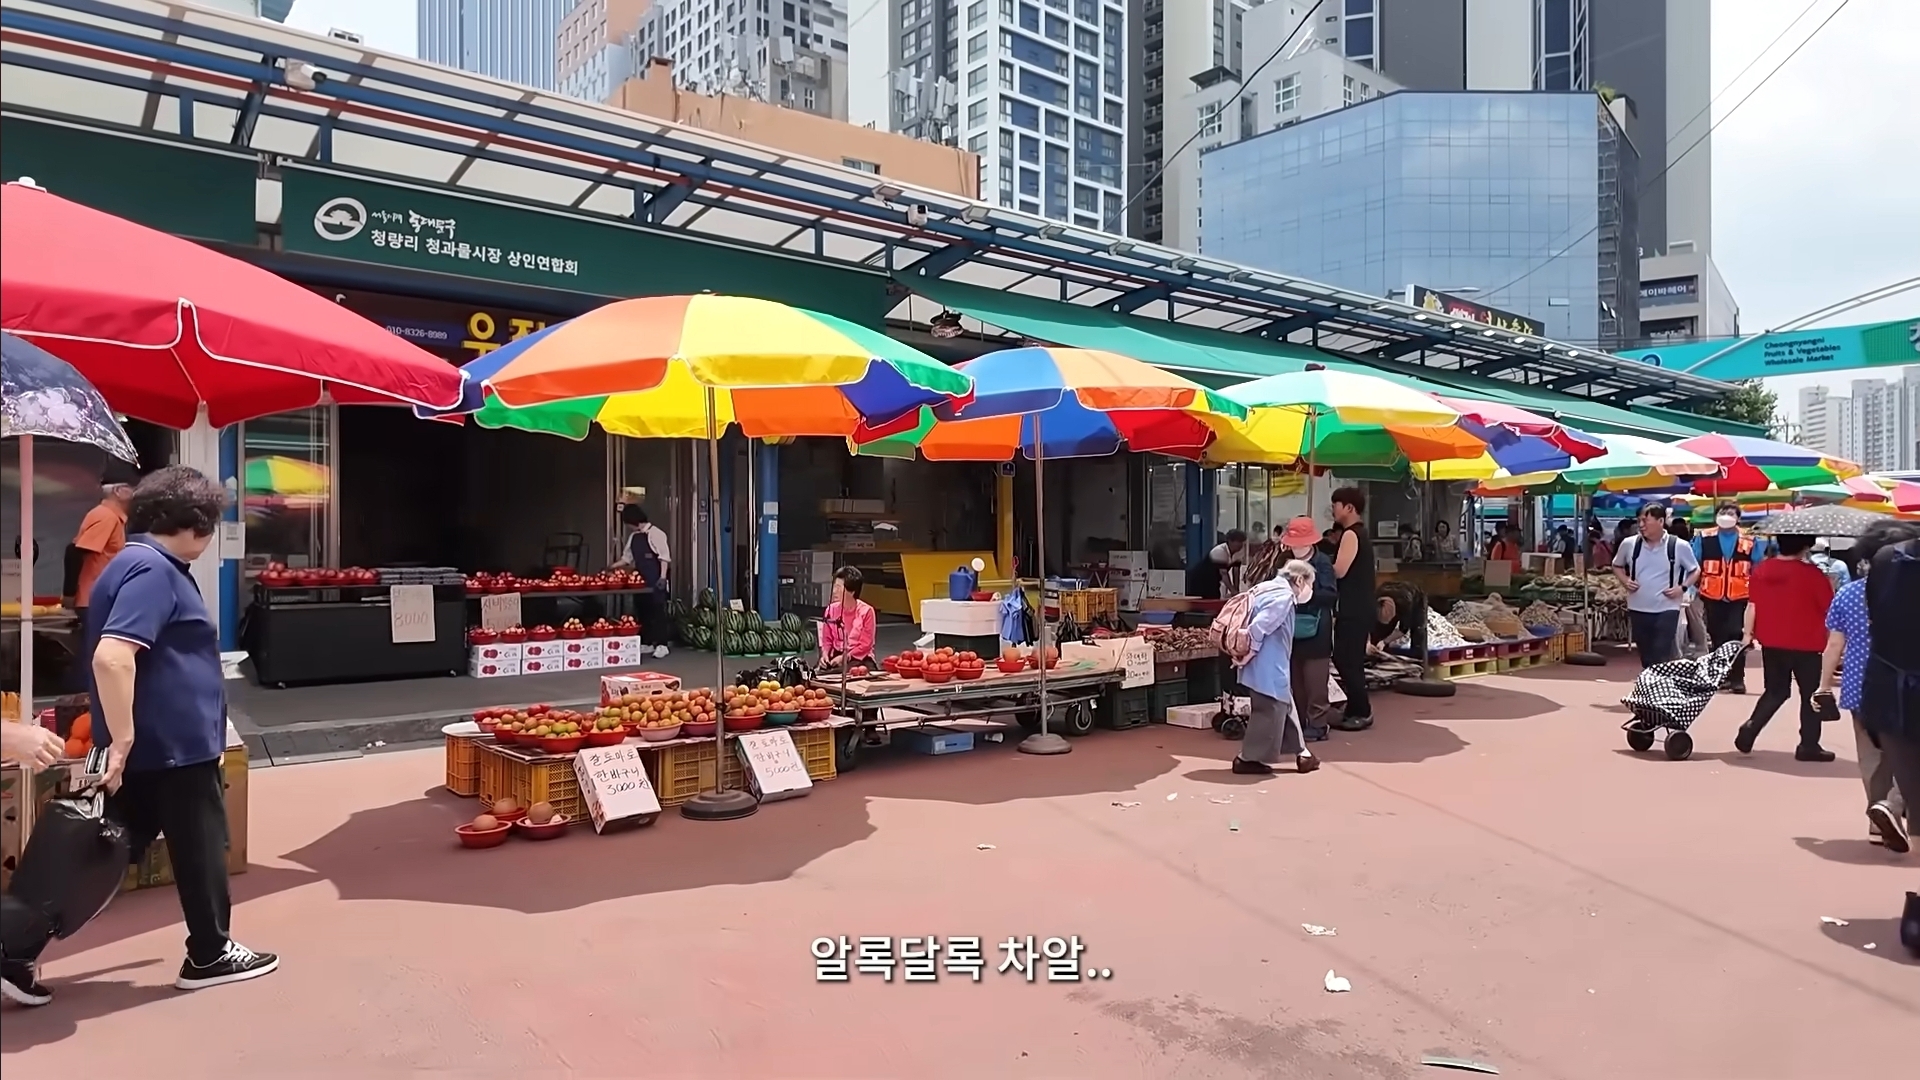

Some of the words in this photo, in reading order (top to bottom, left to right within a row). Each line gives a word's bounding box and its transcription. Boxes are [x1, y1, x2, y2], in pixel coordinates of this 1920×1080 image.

[371, 228, 419, 252] 청량리
[425, 238, 502, 264] 청과물시장
[507, 251, 579, 276] 상인연합회
[1764, 336, 1826, 350] Cheongnyangni
[1764, 350, 1786, 358] Fruits
[1796, 344, 1842, 355] Vegetables
[1764, 356, 1804, 366] Wholesale
[1806, 354, 1834, 362] Market
